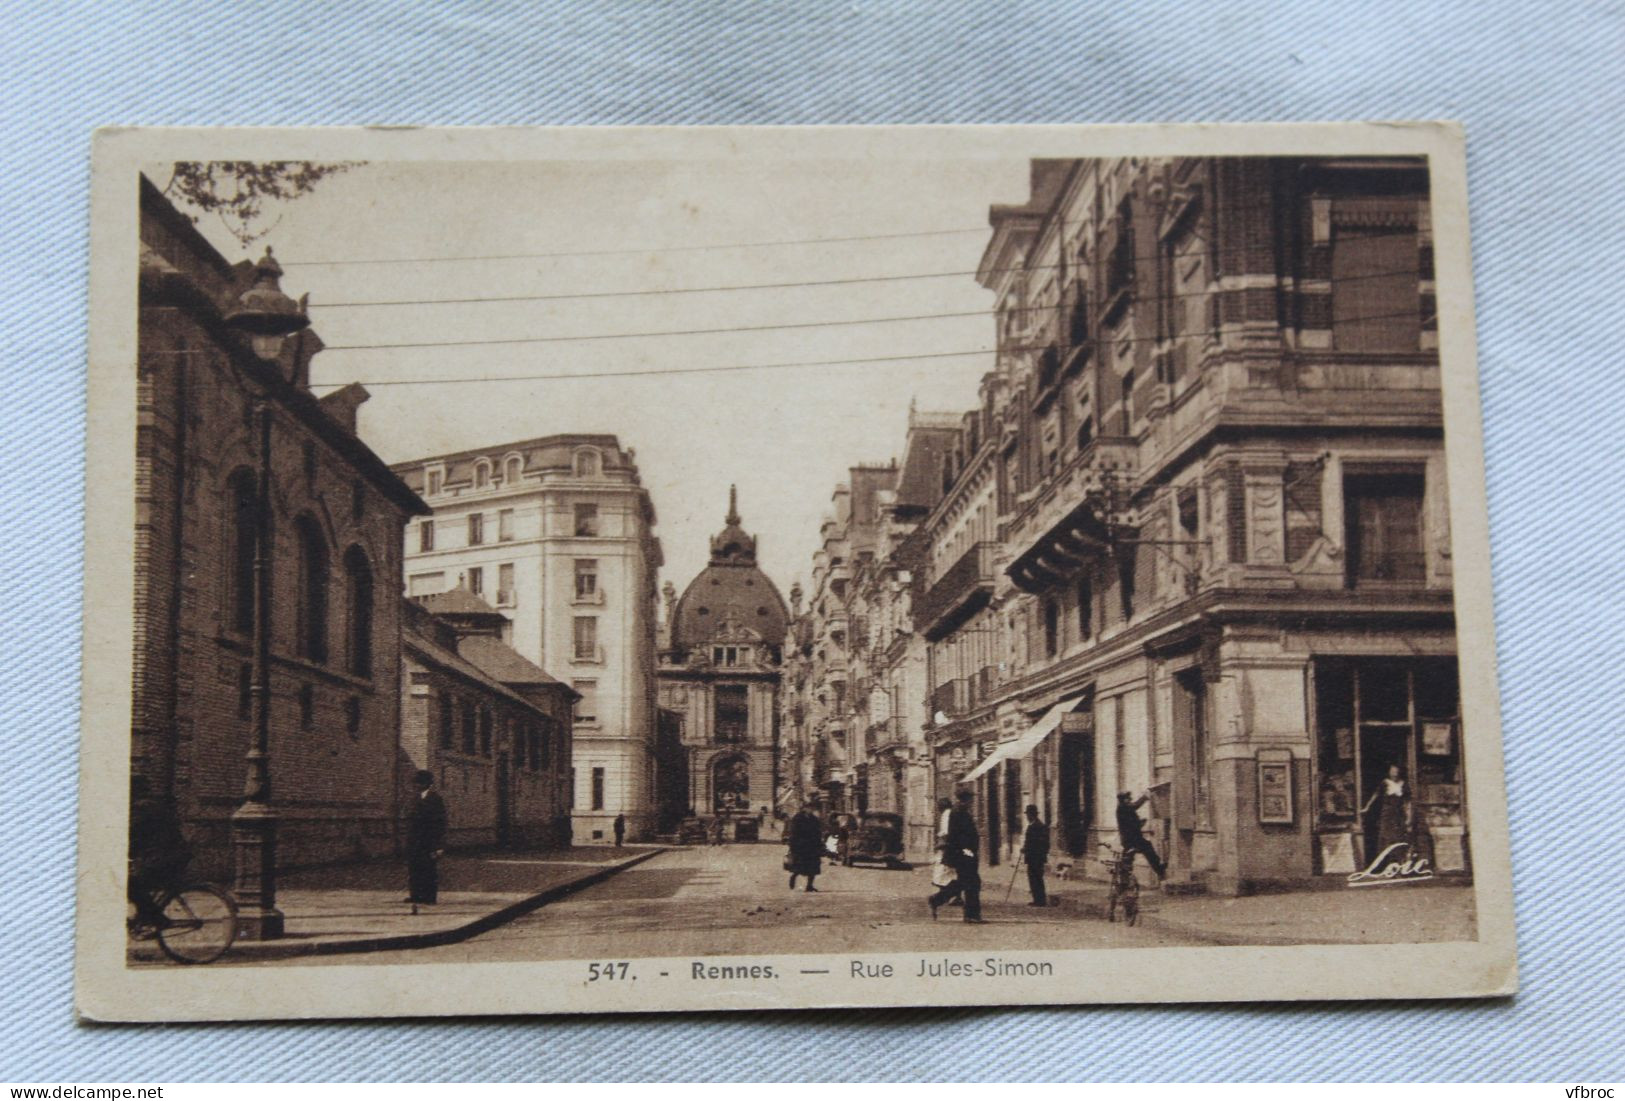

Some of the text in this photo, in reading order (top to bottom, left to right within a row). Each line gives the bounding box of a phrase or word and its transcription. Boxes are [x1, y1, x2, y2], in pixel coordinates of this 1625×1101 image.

[587, 962, 637, 981] 547.
[691, 961, 779, 980] Rennes.
[850, 960, 894, 978] Rue
[916, 958, 1054, 977] Jules-Simon
